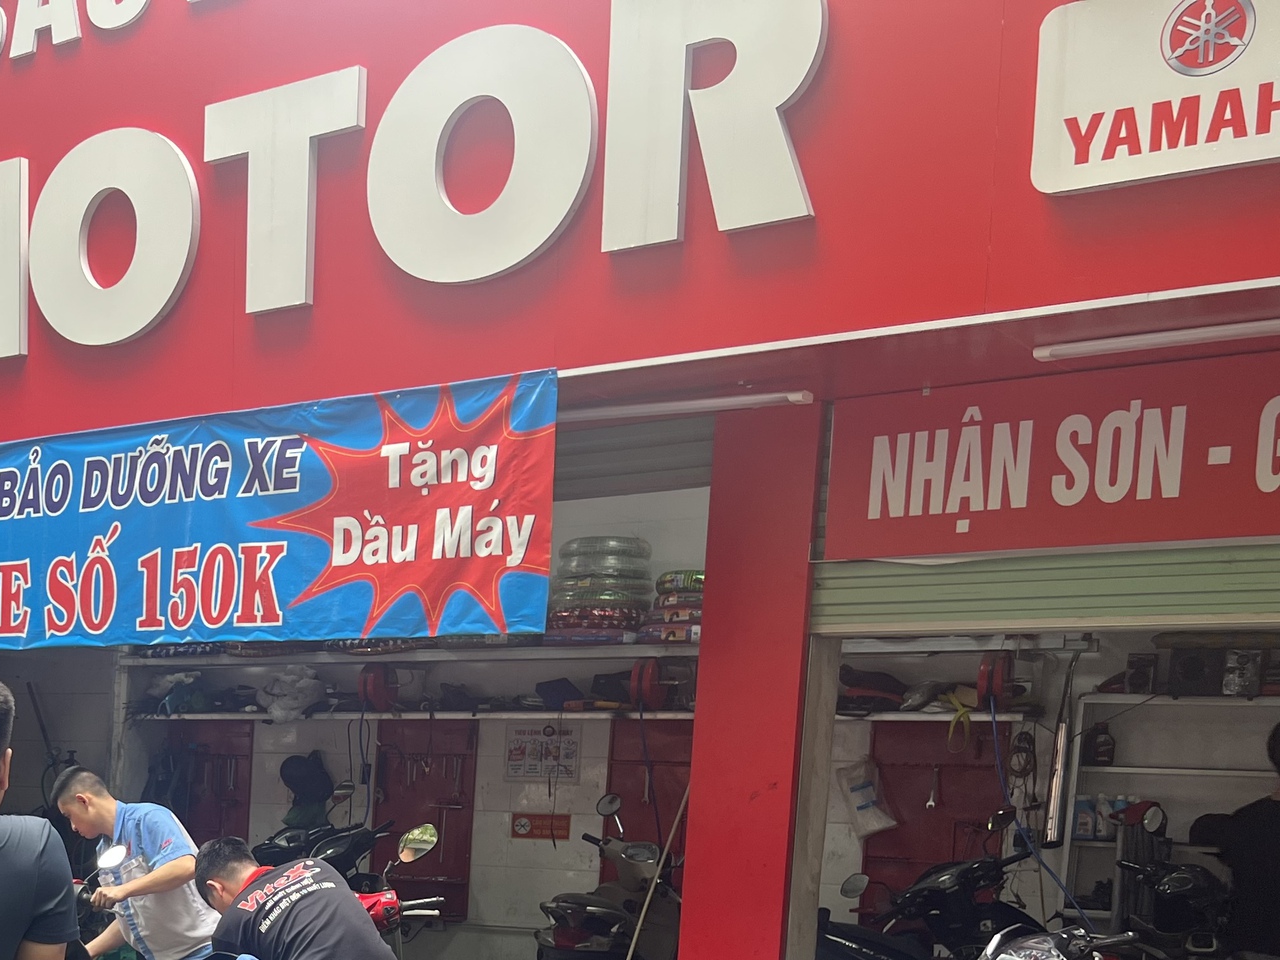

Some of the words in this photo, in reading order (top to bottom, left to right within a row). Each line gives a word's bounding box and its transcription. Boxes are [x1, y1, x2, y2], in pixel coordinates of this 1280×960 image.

[1063, 81, 1280, 167] YAMAH
[78, 434, 232, 512] DƯỠNG
[236, 433, 308, 499] XE
[380, 441, 500, 496] Tặng
[867, 405, 1034, 534] NHẬN
[1050, 399, 1187, 507] SƠN
[331, 509, 418, 568] Dầu
[431, 500, 536, 567] Máy
[44, 521, 122, 636] SỐ
[135, 541, 288, 632] 150K
